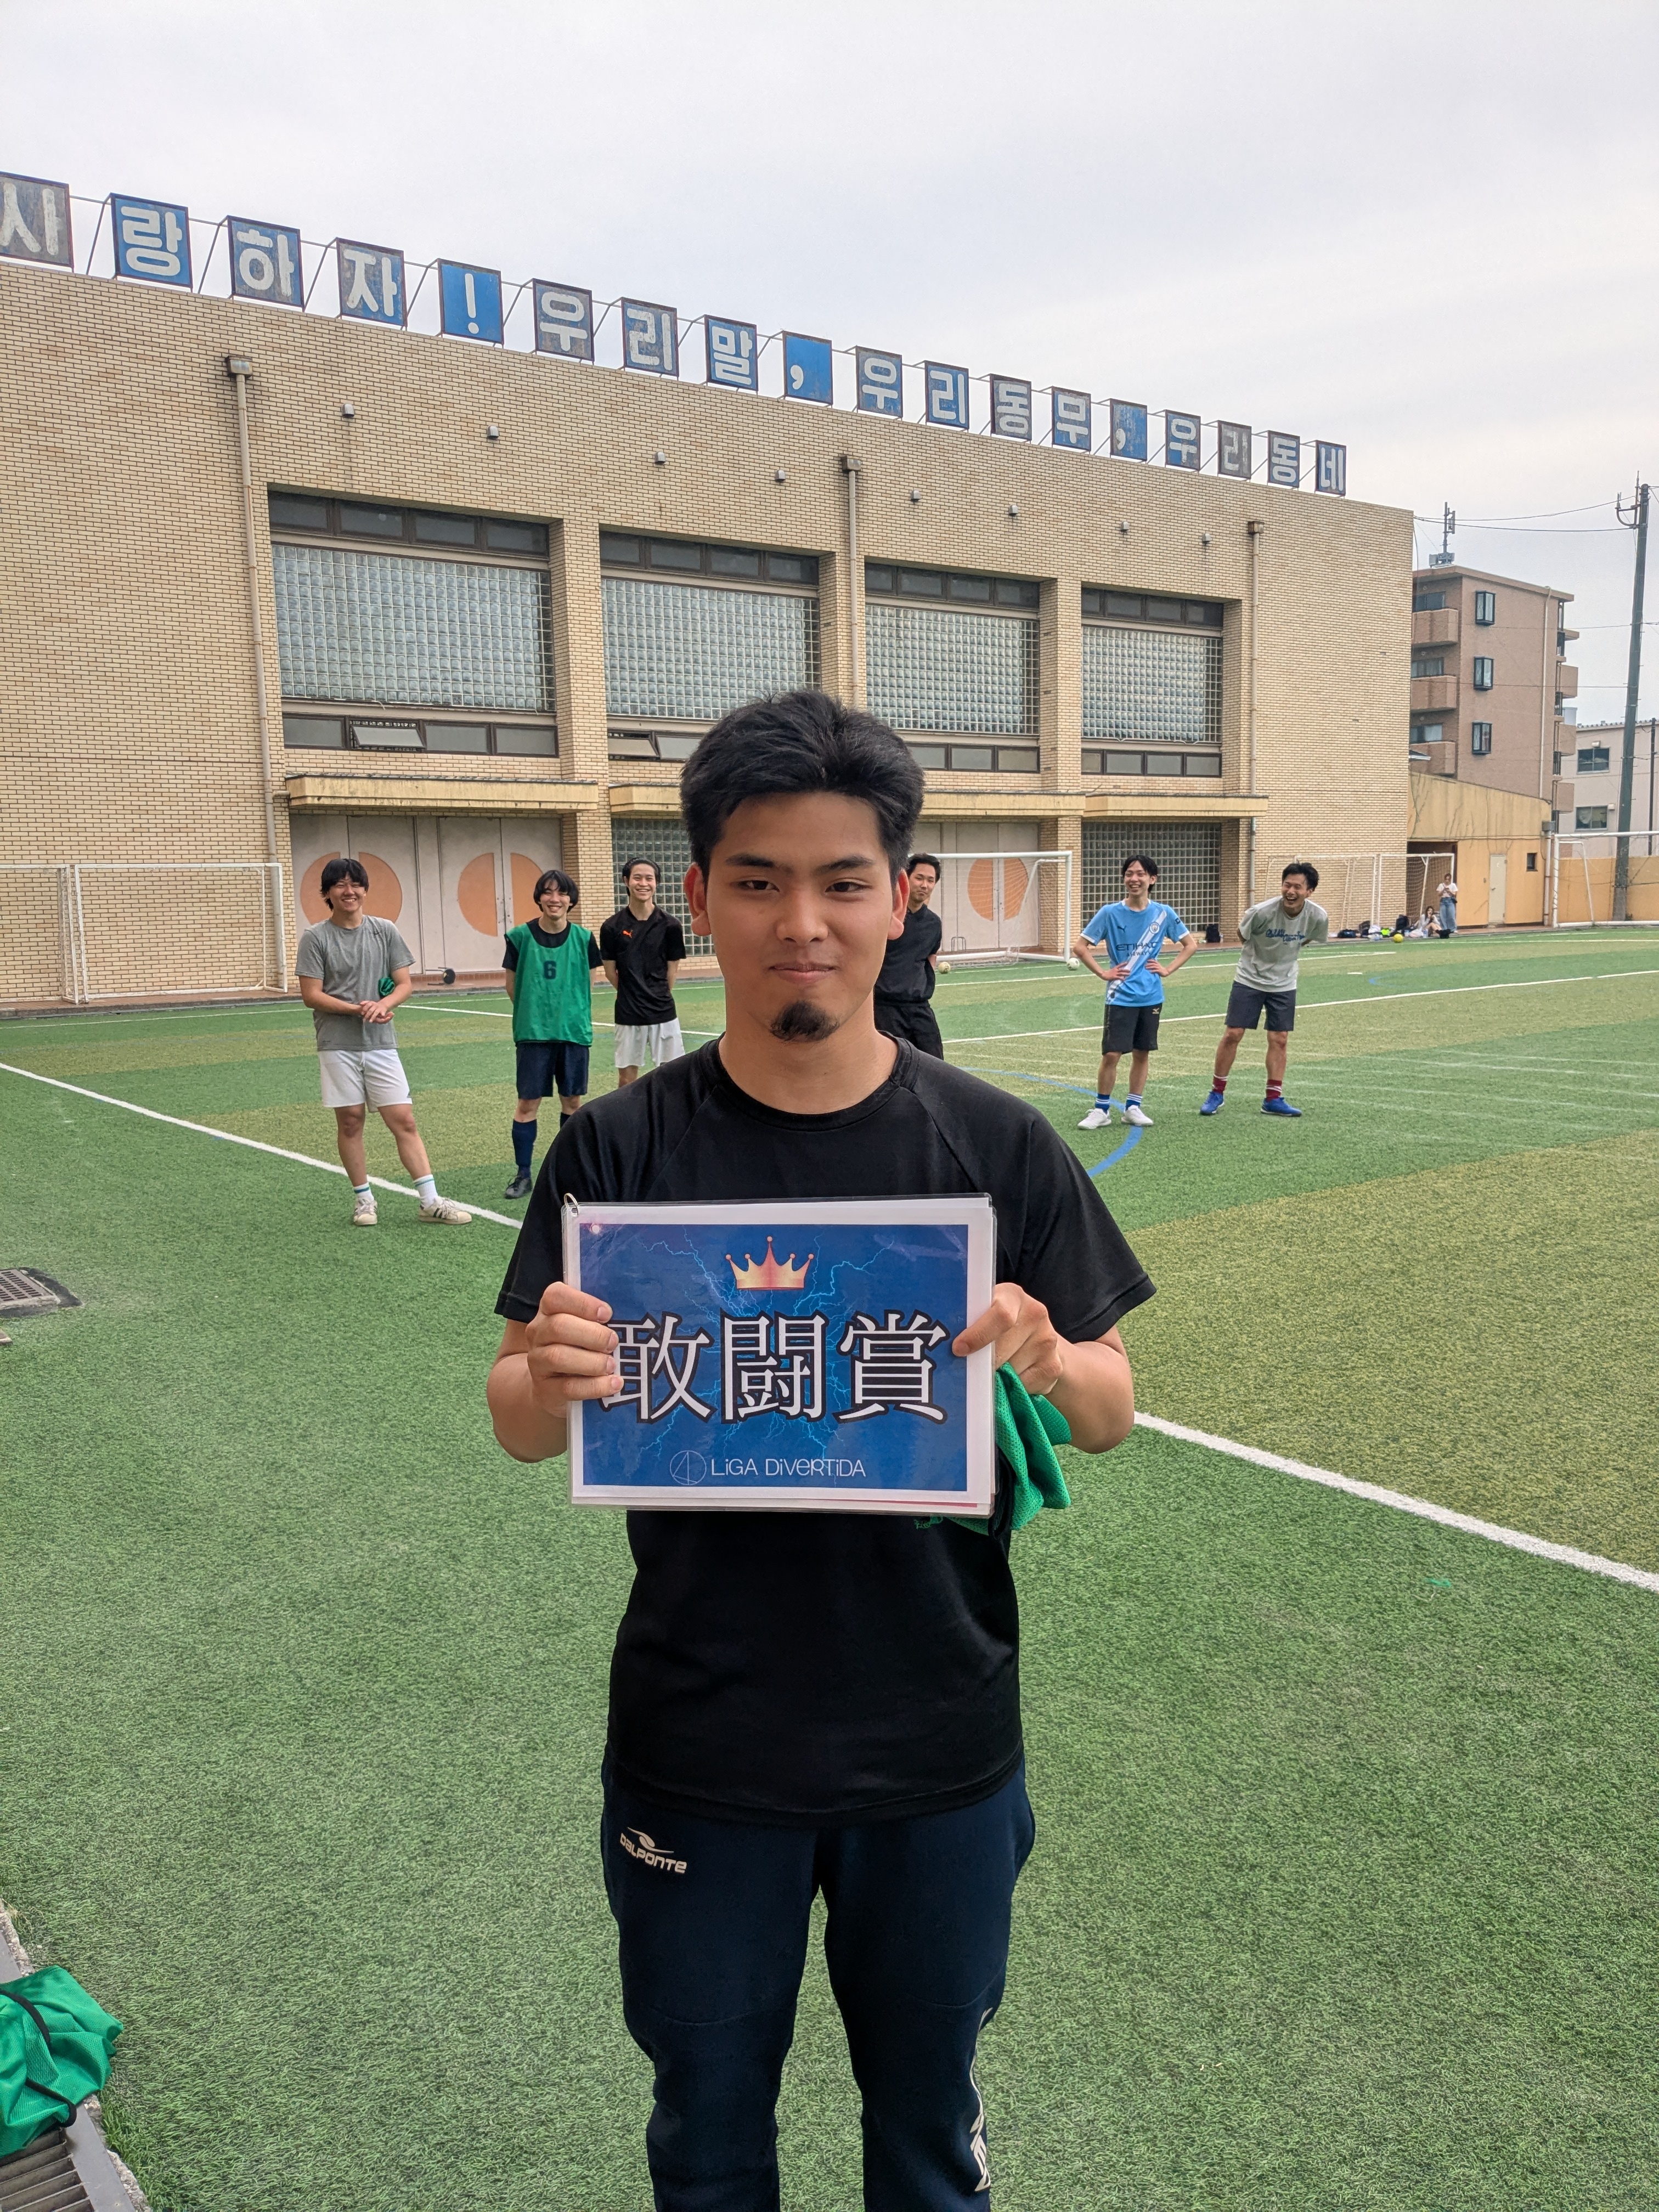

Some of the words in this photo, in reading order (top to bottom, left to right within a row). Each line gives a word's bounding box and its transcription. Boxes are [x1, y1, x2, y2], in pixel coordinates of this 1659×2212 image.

[544, 961, 556, 980] 6
[598, 1310, 947, 1424] 敢闘賞
